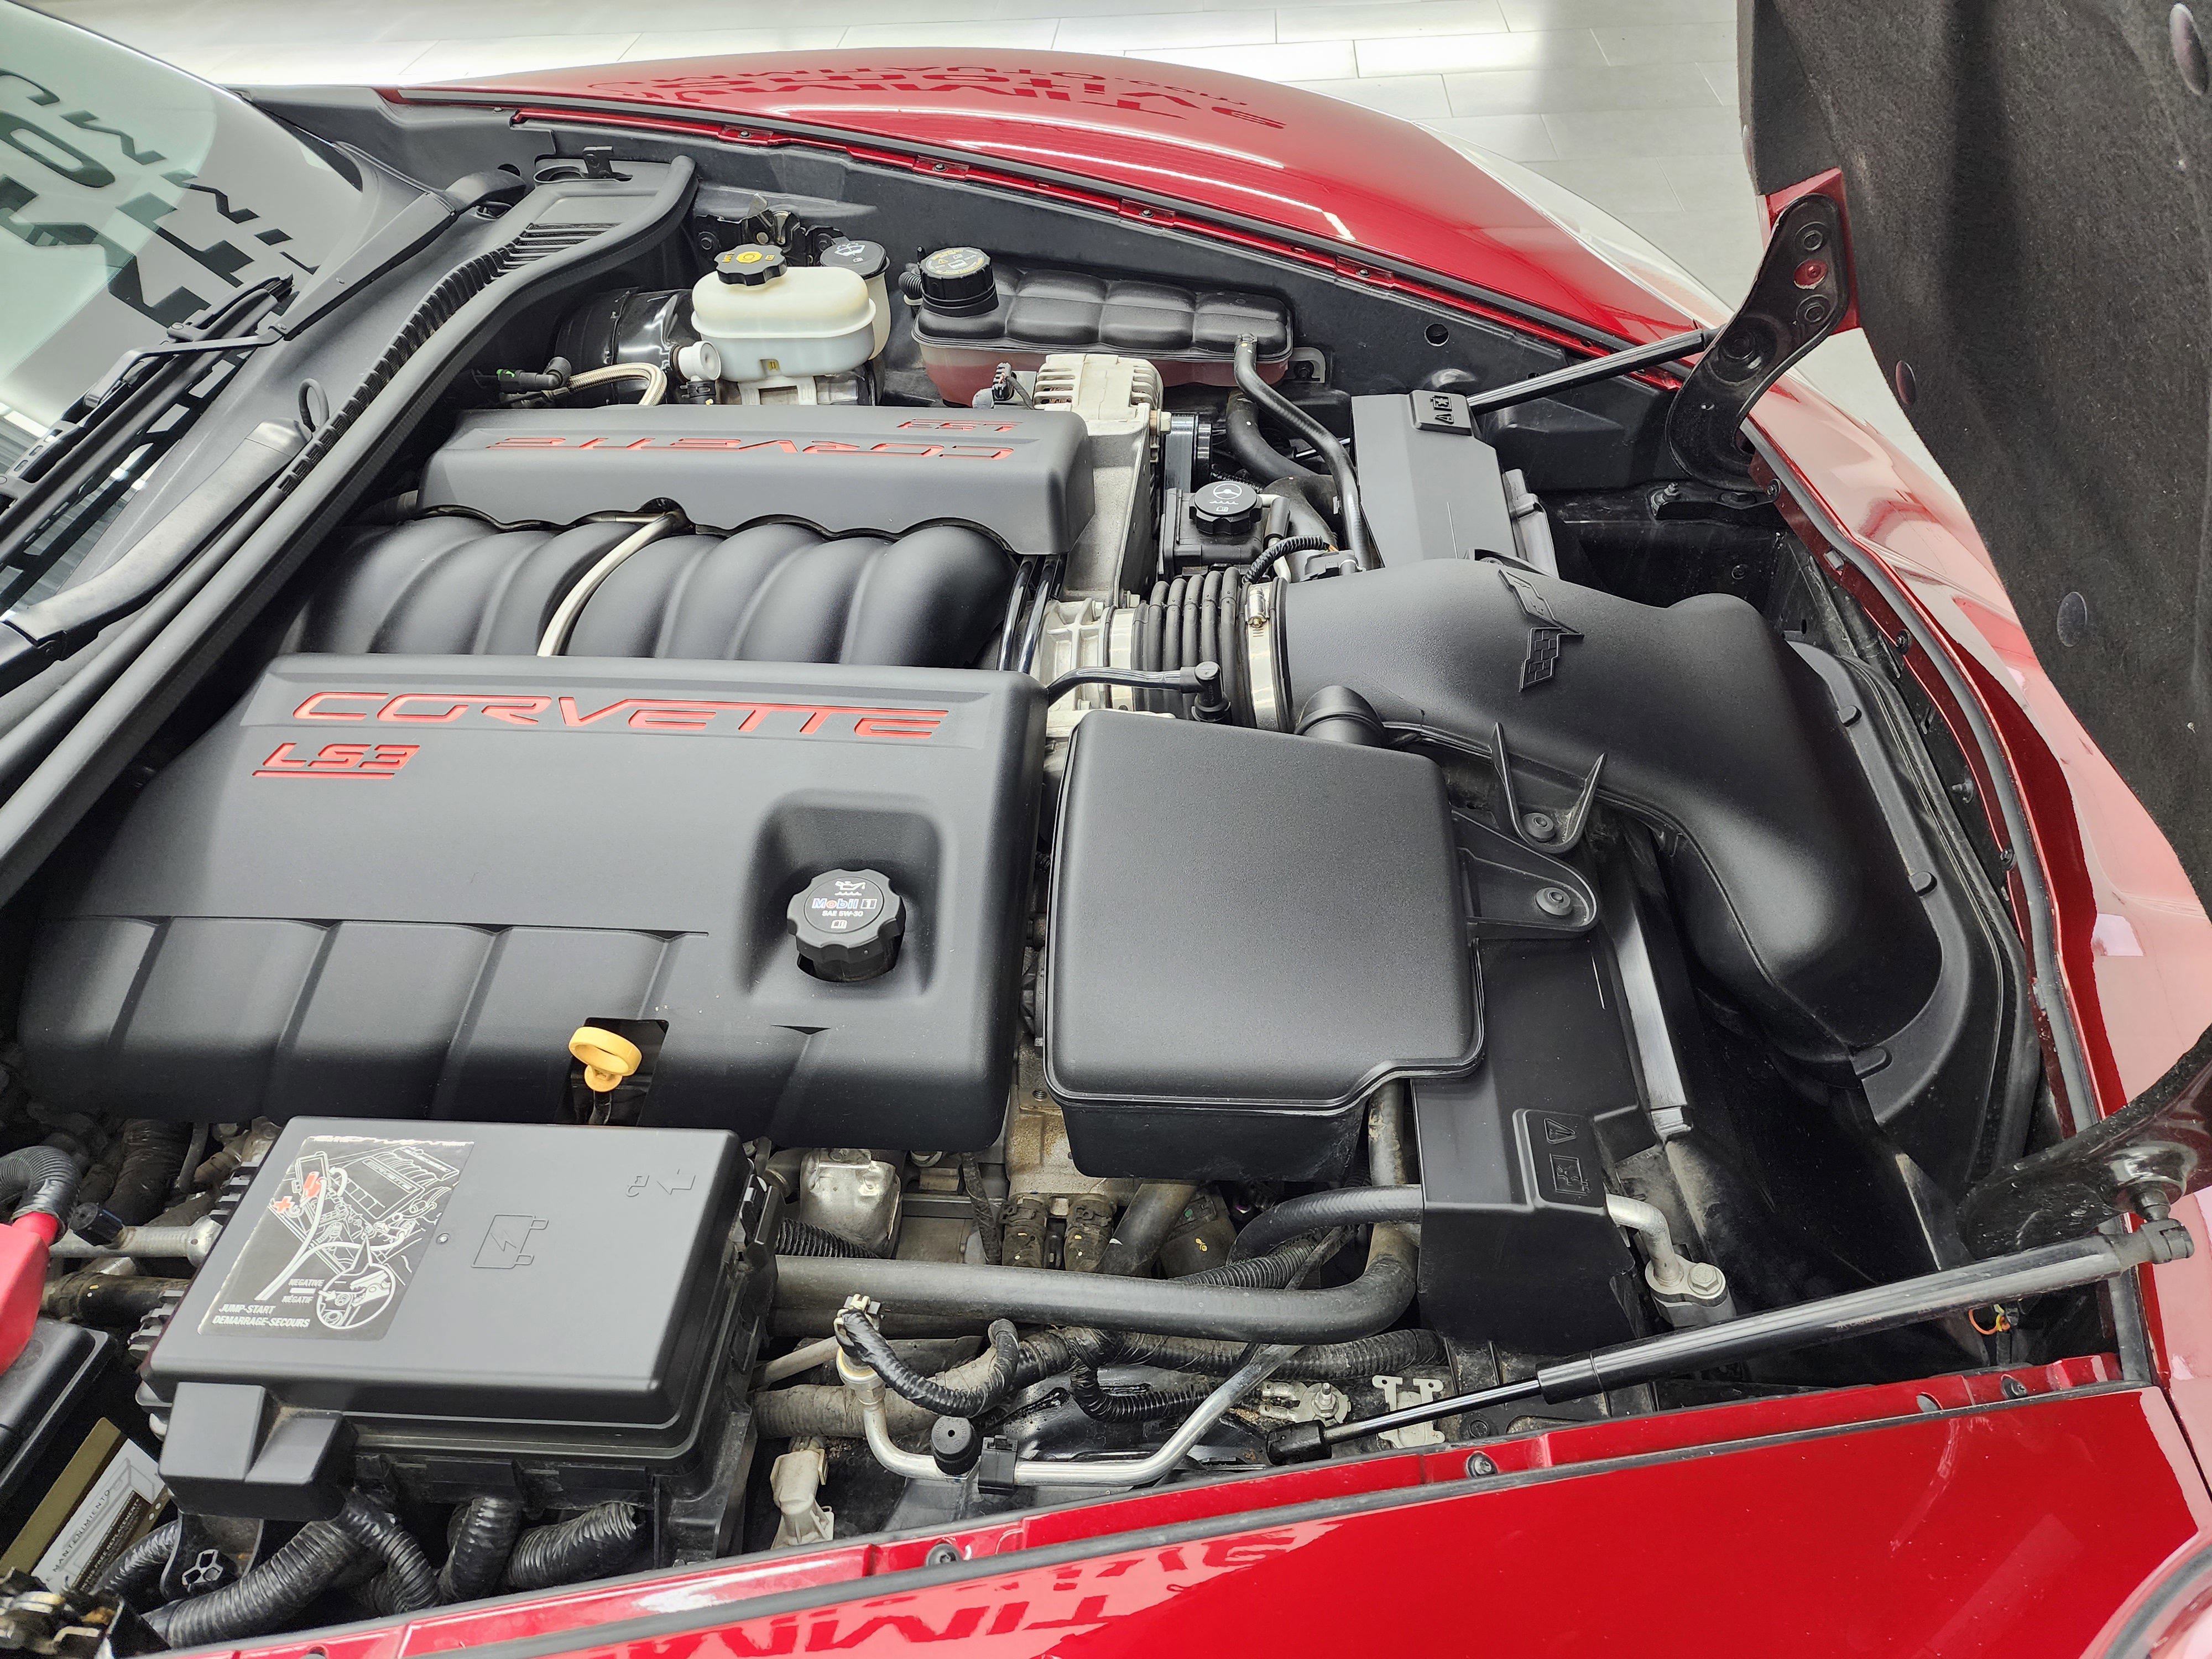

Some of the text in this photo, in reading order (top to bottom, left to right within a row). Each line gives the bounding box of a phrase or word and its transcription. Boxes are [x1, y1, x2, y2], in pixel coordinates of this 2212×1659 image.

[896, 419, 1019, 432] LS3
[484, 437, 1015, 460] CORVETTE
[293, 692, 948, 738] CORVETTE
[262, 743, 420, 769] LS3
[811, 898, 859, 909] Mobil
[288, 1279, 325, 1287] NEGATIVE
[281, 1295, 315, 1304] NÉGATIF
[218, 1303, 276, 1314] JUMP-START
